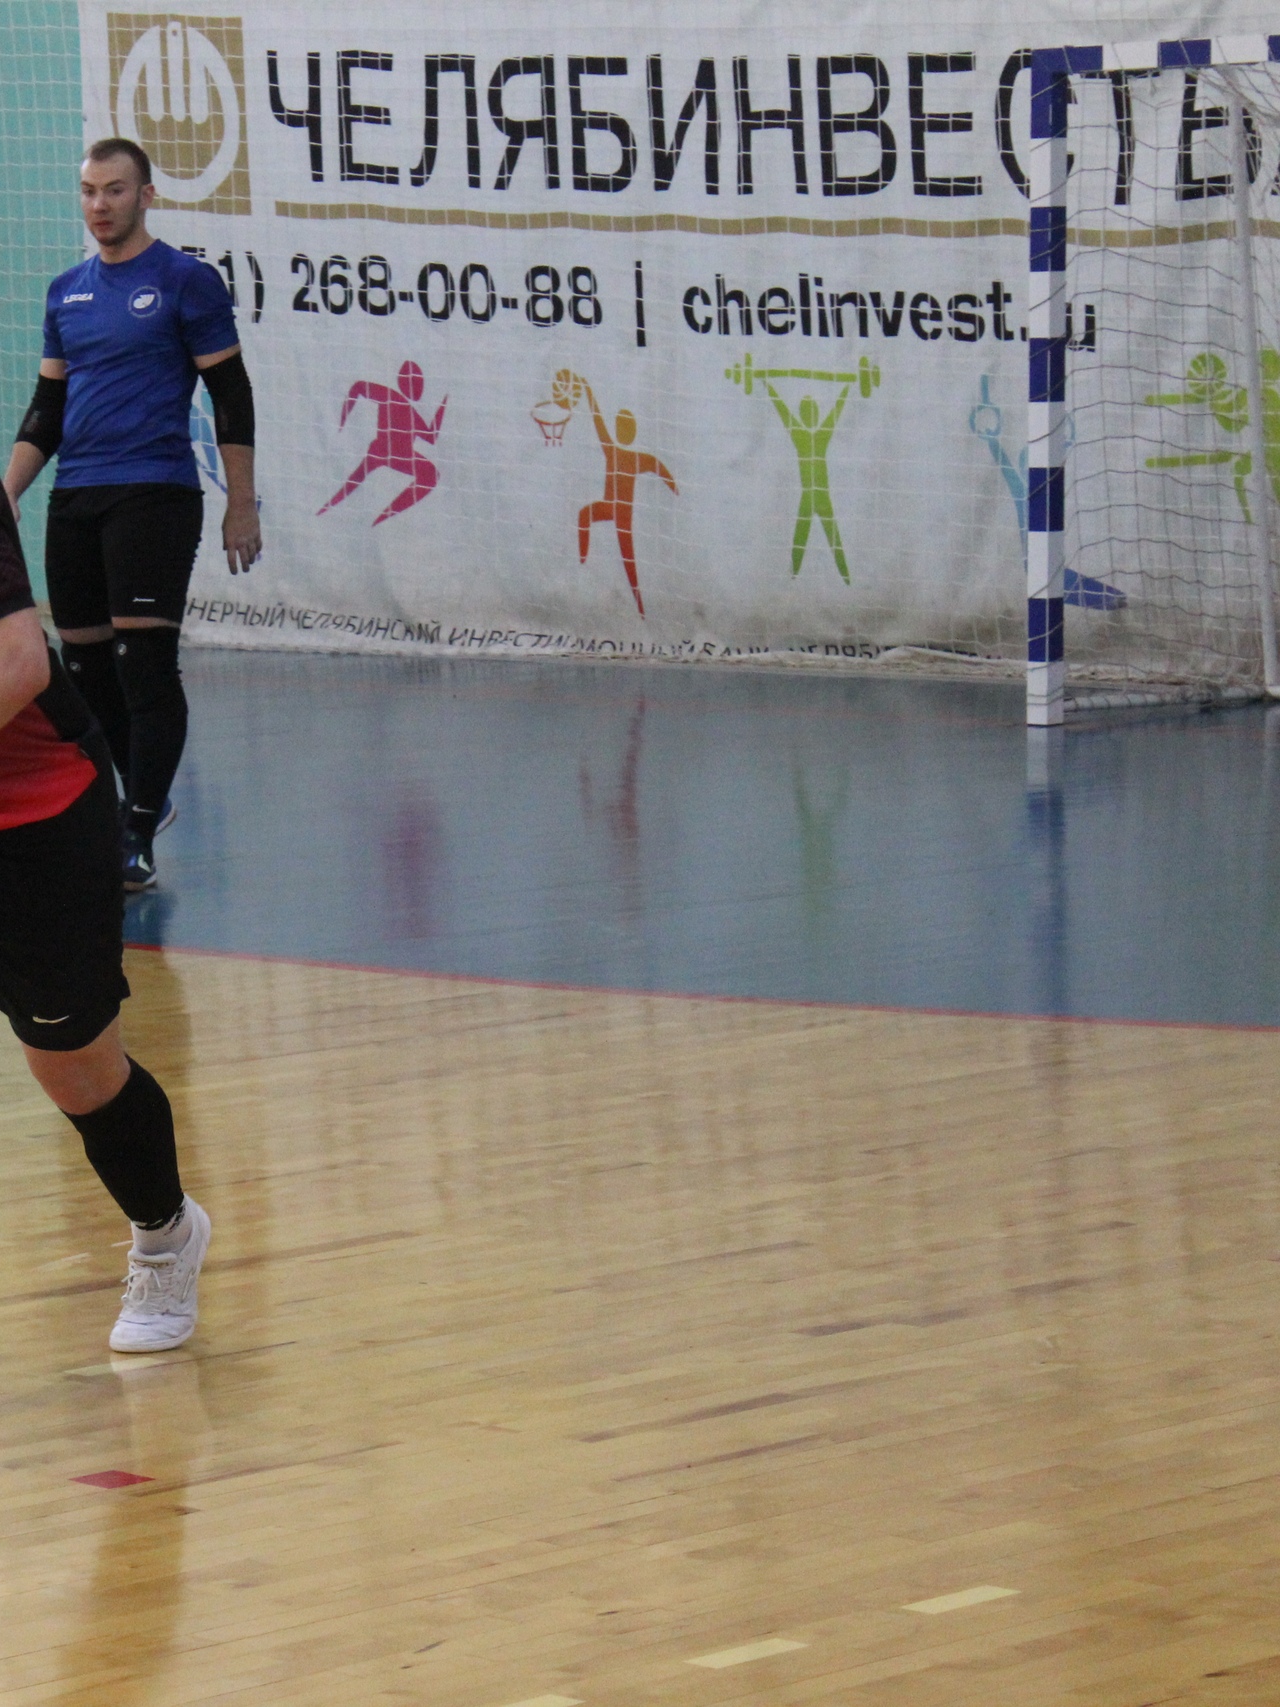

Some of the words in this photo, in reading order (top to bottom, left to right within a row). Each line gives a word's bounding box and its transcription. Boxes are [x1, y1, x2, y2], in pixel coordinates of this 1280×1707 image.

[266, 48, 1280, 206] ЧЕЛЯБИНВЕСТБ
[290, 252, 603, 328] 268-00-88
[681, 272, 1096, 353] chelinvest.u
[186, 597, 286, 629] НЕРНЫЙ
